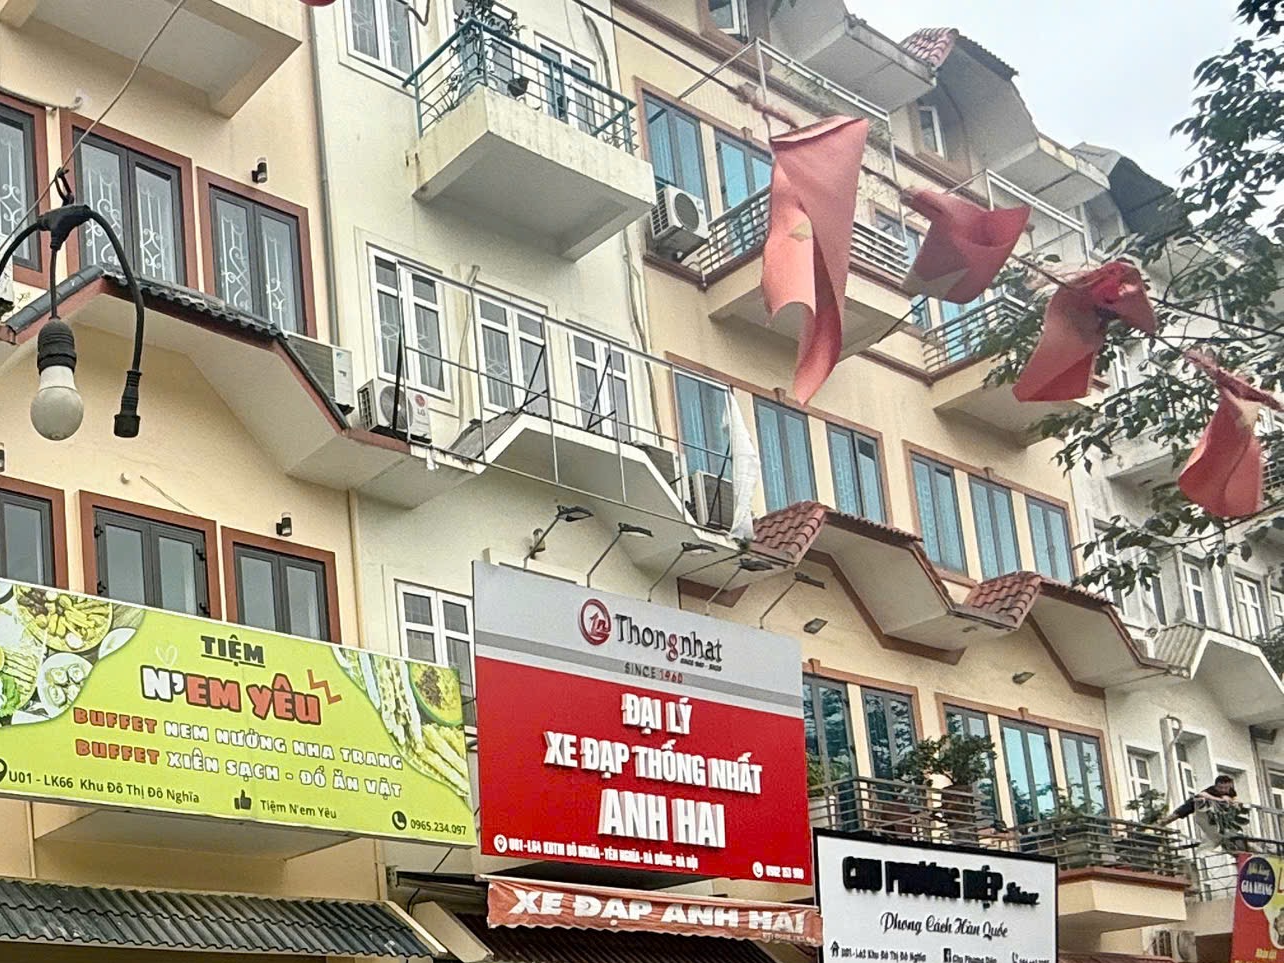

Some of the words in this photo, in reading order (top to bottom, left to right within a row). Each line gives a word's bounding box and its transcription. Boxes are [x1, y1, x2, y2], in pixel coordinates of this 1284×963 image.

[201, 634, 265, 667] TIỆM
[615, 614, 723, 663] Thongnhat
[624, 662, 656, 679] SINCE
[622, 692, 663, 735] ĐẠI
[665, 697, 693, 735] LÝ
[73, 707, 158, 735] BUFFET
[164, 720, 210, 742] NEM
[215, 728, 287, 753] NƯỚNG
[292, 740, 335, 760] NHA
[339, 748, 404, 770] TRANG
[75, 739, 160, 765] BUFFET
[167, 747, 219, 773] XIÊN
[225, 760, 280, 783] SẠCH
[332, 769, 359, 792] ĂN
[364, 777, 403, 800] VẶT
[543, 731, 578, 769] XE
[580, 740, 630, 780] ĐẠP
[631, 738, 707, 786] THỐNG
[708, 751, 763, 795] NHẤT
[8, 770, 33, 785] U01
[43, 775, 74, 789] LK66
[79, 778, 104, 793] Khu
[107, 781, 124, 795] Đô
[126, 783, 145, 800] Thị
[147, 786, 164, 799] Đô
[166, 788, 200, 805] Nghĩa
[260, 799, 287, 815] Tiệm
[319, 804, 337, 819] Yêu
[598, 788, 669, 842] ANH
[672, 798, 727, 849] HAI
[508, 889, 565, 917] XE
[572, 895, 653, 927] ĐẠP
[660, 902, 739, 929] ANH
[748, 911, 805, 935] HAI
[880, 912, 923, 936] Phong
[925, 914, 953, 933] Cách
[953, 917, 980, 936] Hàn
